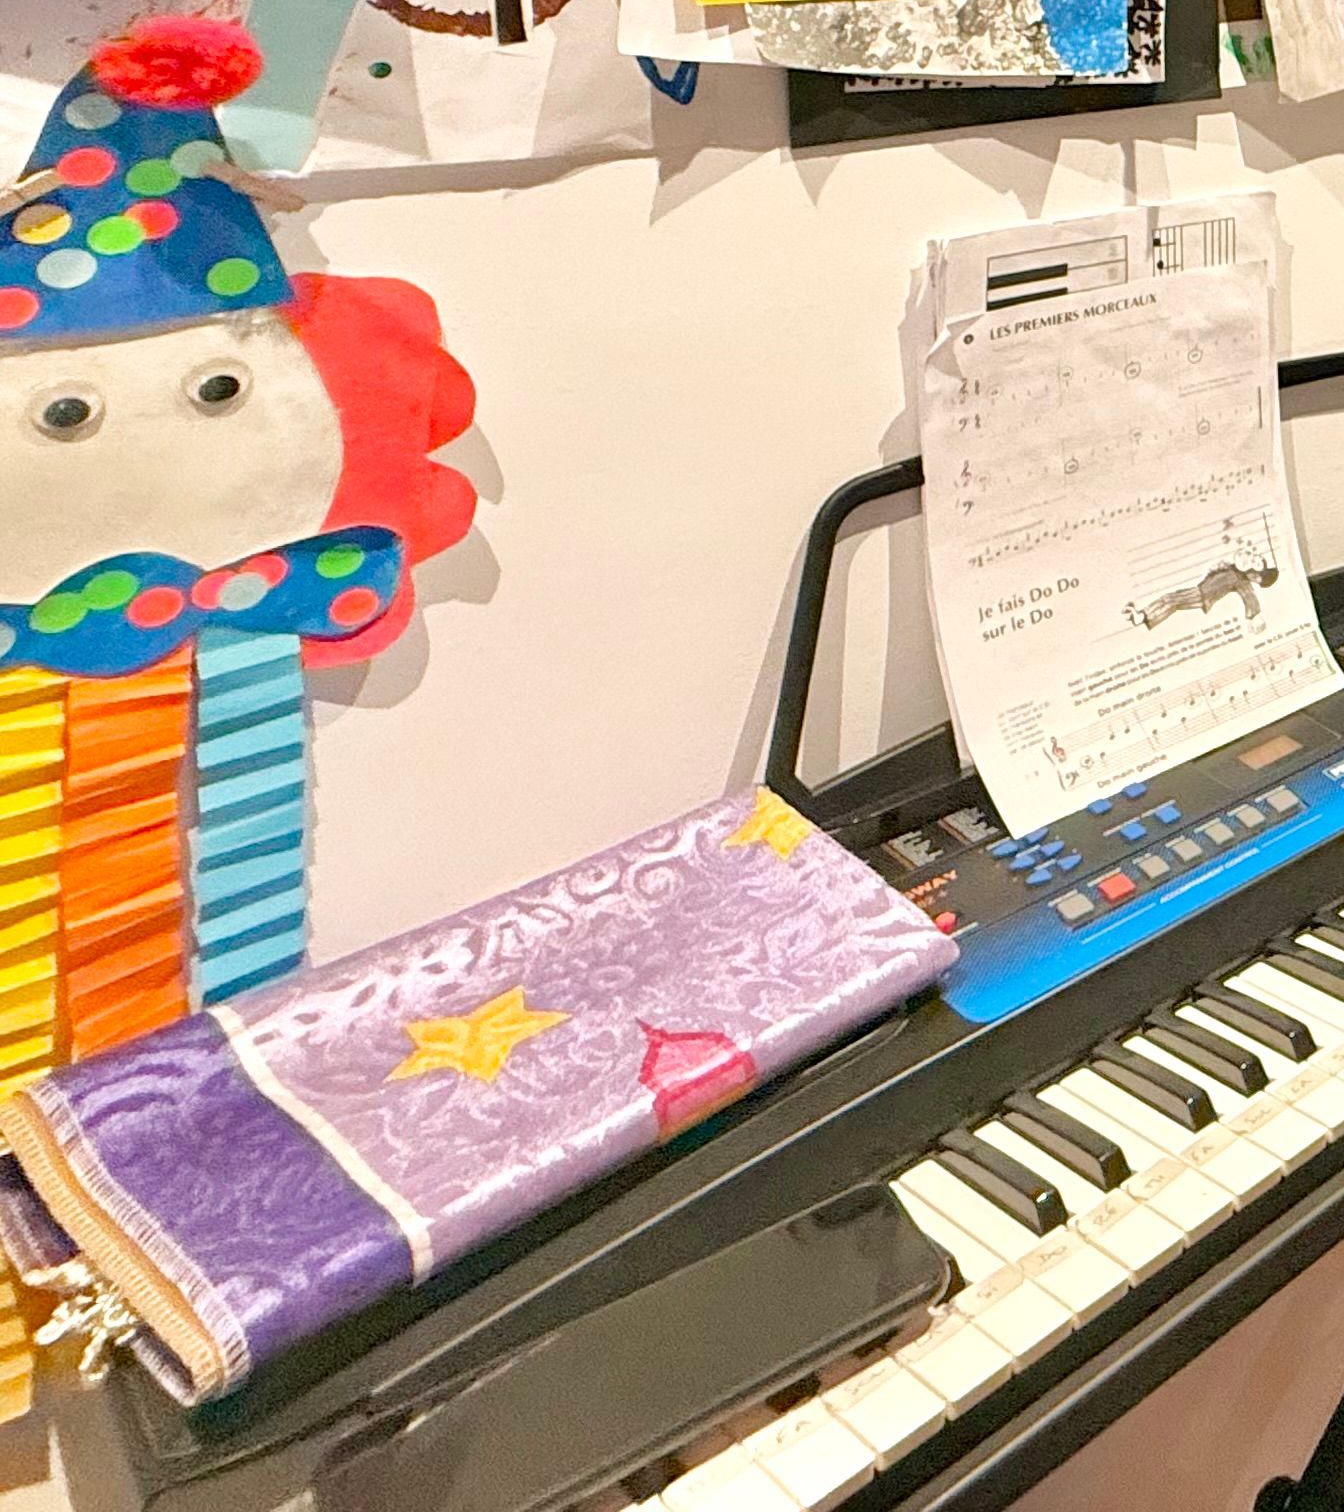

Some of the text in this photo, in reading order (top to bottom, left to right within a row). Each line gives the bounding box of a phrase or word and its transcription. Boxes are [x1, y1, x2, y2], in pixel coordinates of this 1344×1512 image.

[989, 320, 1011, 341] LES
[1014, 309, 1080, 335] PREMIERS
[1083, 292, 1157, 319] MORCEAUX
[978, 577, 1080, 624] Je fais Do Do
[982, 608, 1053, 642] sur le Do
[1098, 686, 1162, 718] Do main droite
[1097, 778, 1111, 790] Do
[1112, 768, 1135, 783] main
